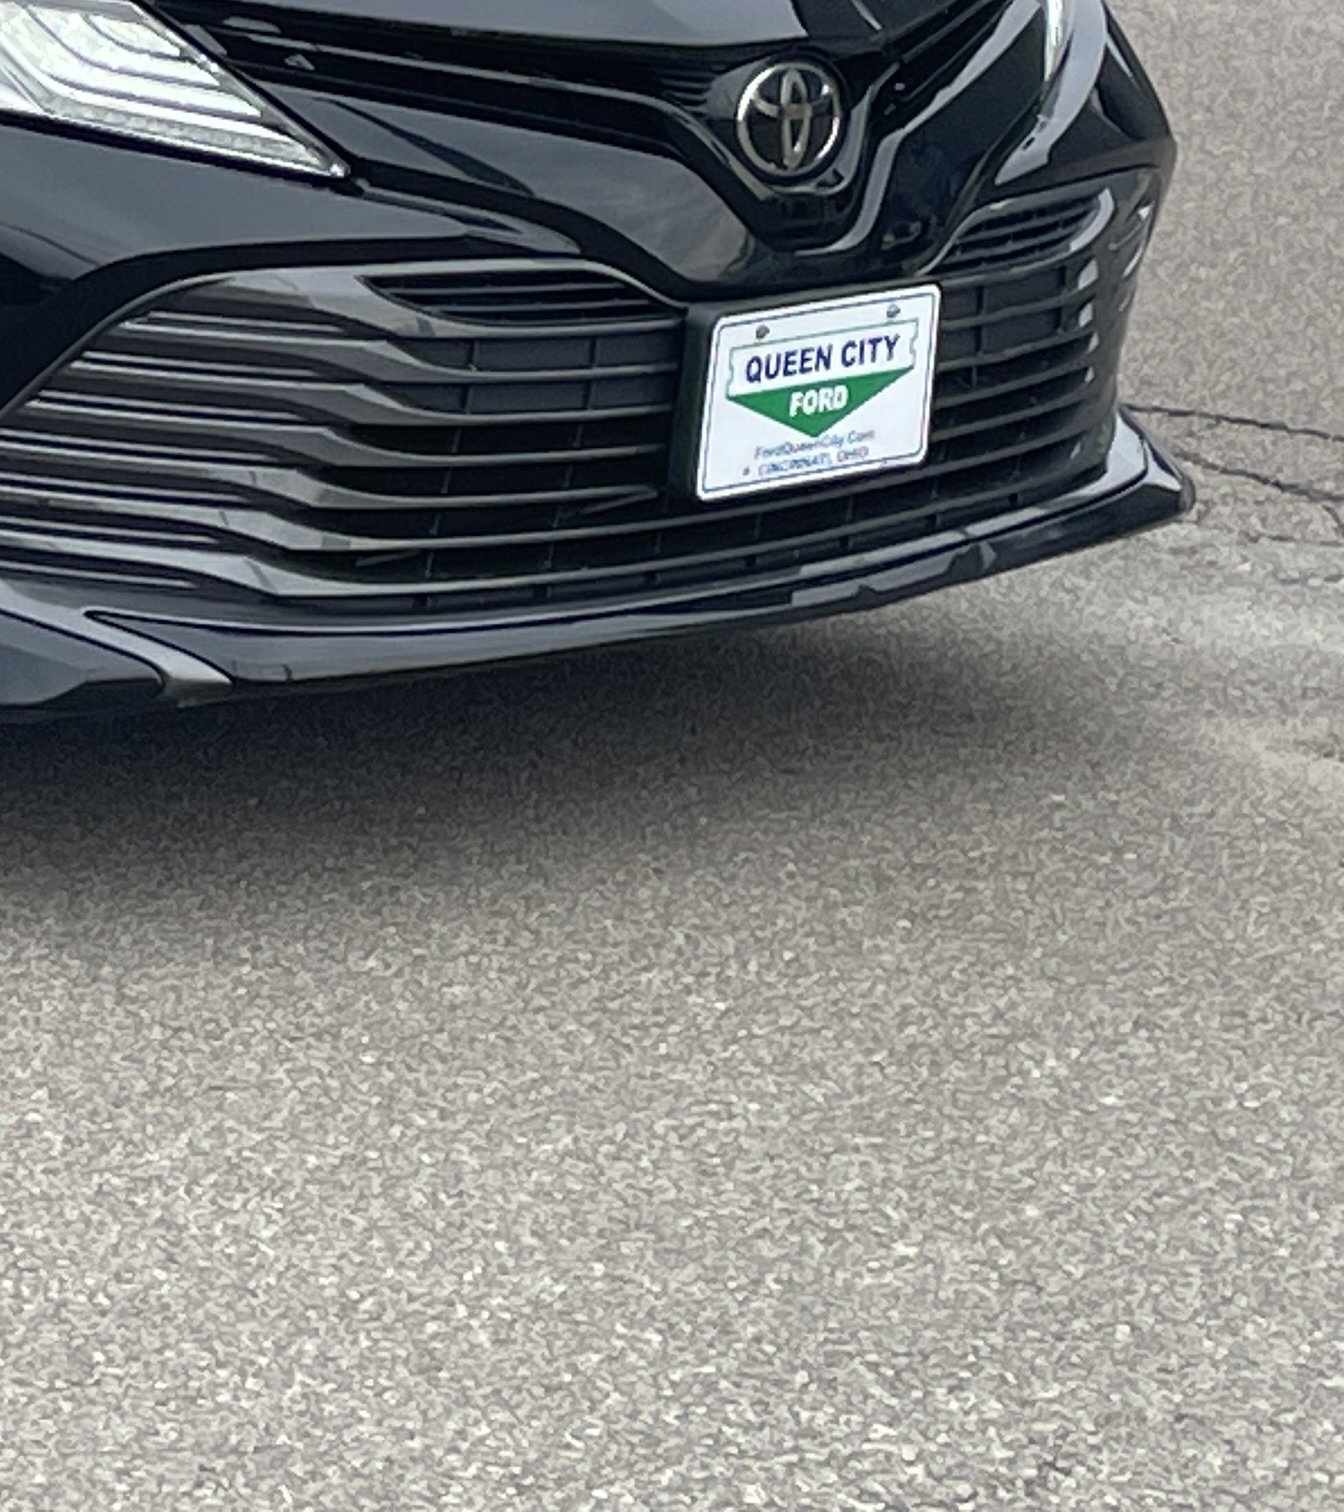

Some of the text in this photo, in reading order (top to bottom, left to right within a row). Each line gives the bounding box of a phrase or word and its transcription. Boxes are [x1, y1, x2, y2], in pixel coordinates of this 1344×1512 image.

[746, 334, 901, 384] QUEEN CITY
[789, 385, 849, 417] FORD
